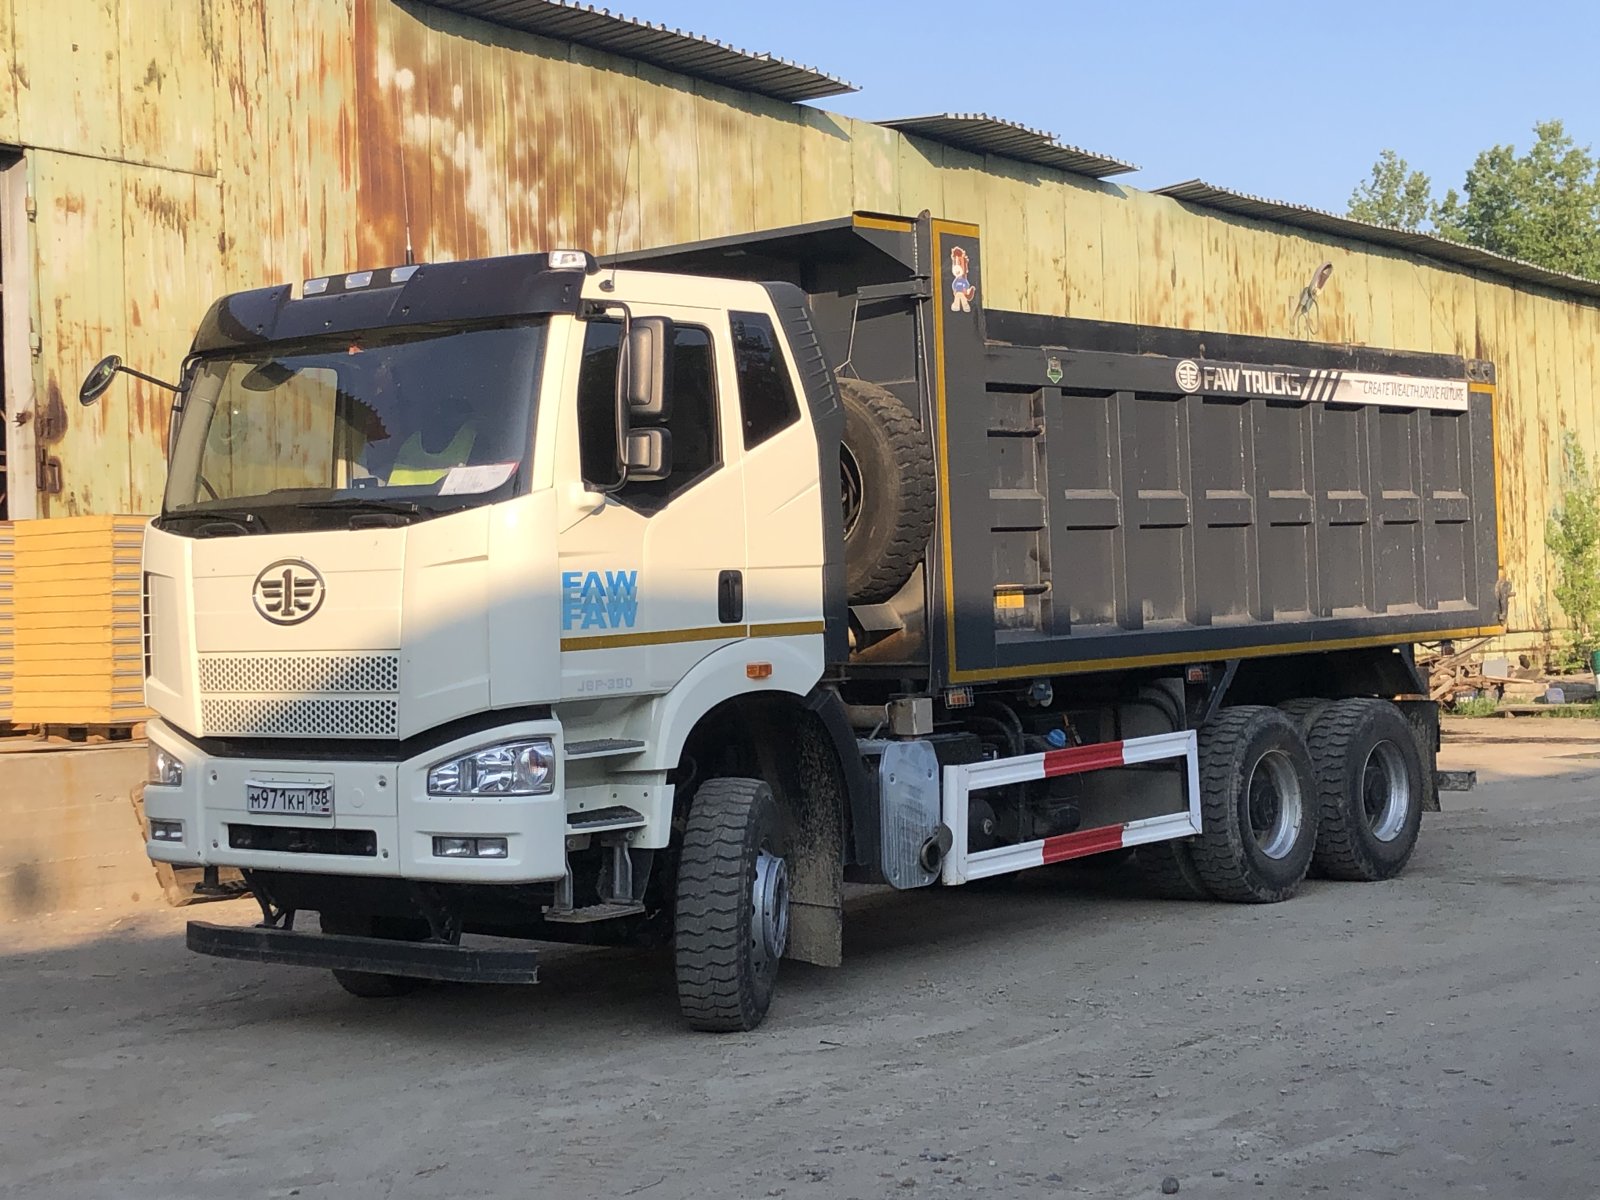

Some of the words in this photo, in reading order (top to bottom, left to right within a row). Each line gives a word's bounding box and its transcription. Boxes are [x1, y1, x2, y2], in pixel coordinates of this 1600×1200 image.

[1203, 366, 1239, 392] FAW
[1242, 370, 1301, 396] TRUCKS
[1363, 380, 1390, 397] CREATE
[1440, 386, 1464, 402] FUTURE
[562, 571, 637, 597] FAW
[562, 602, 638, 630] FAW
[308, 788, 329, 806] 138
